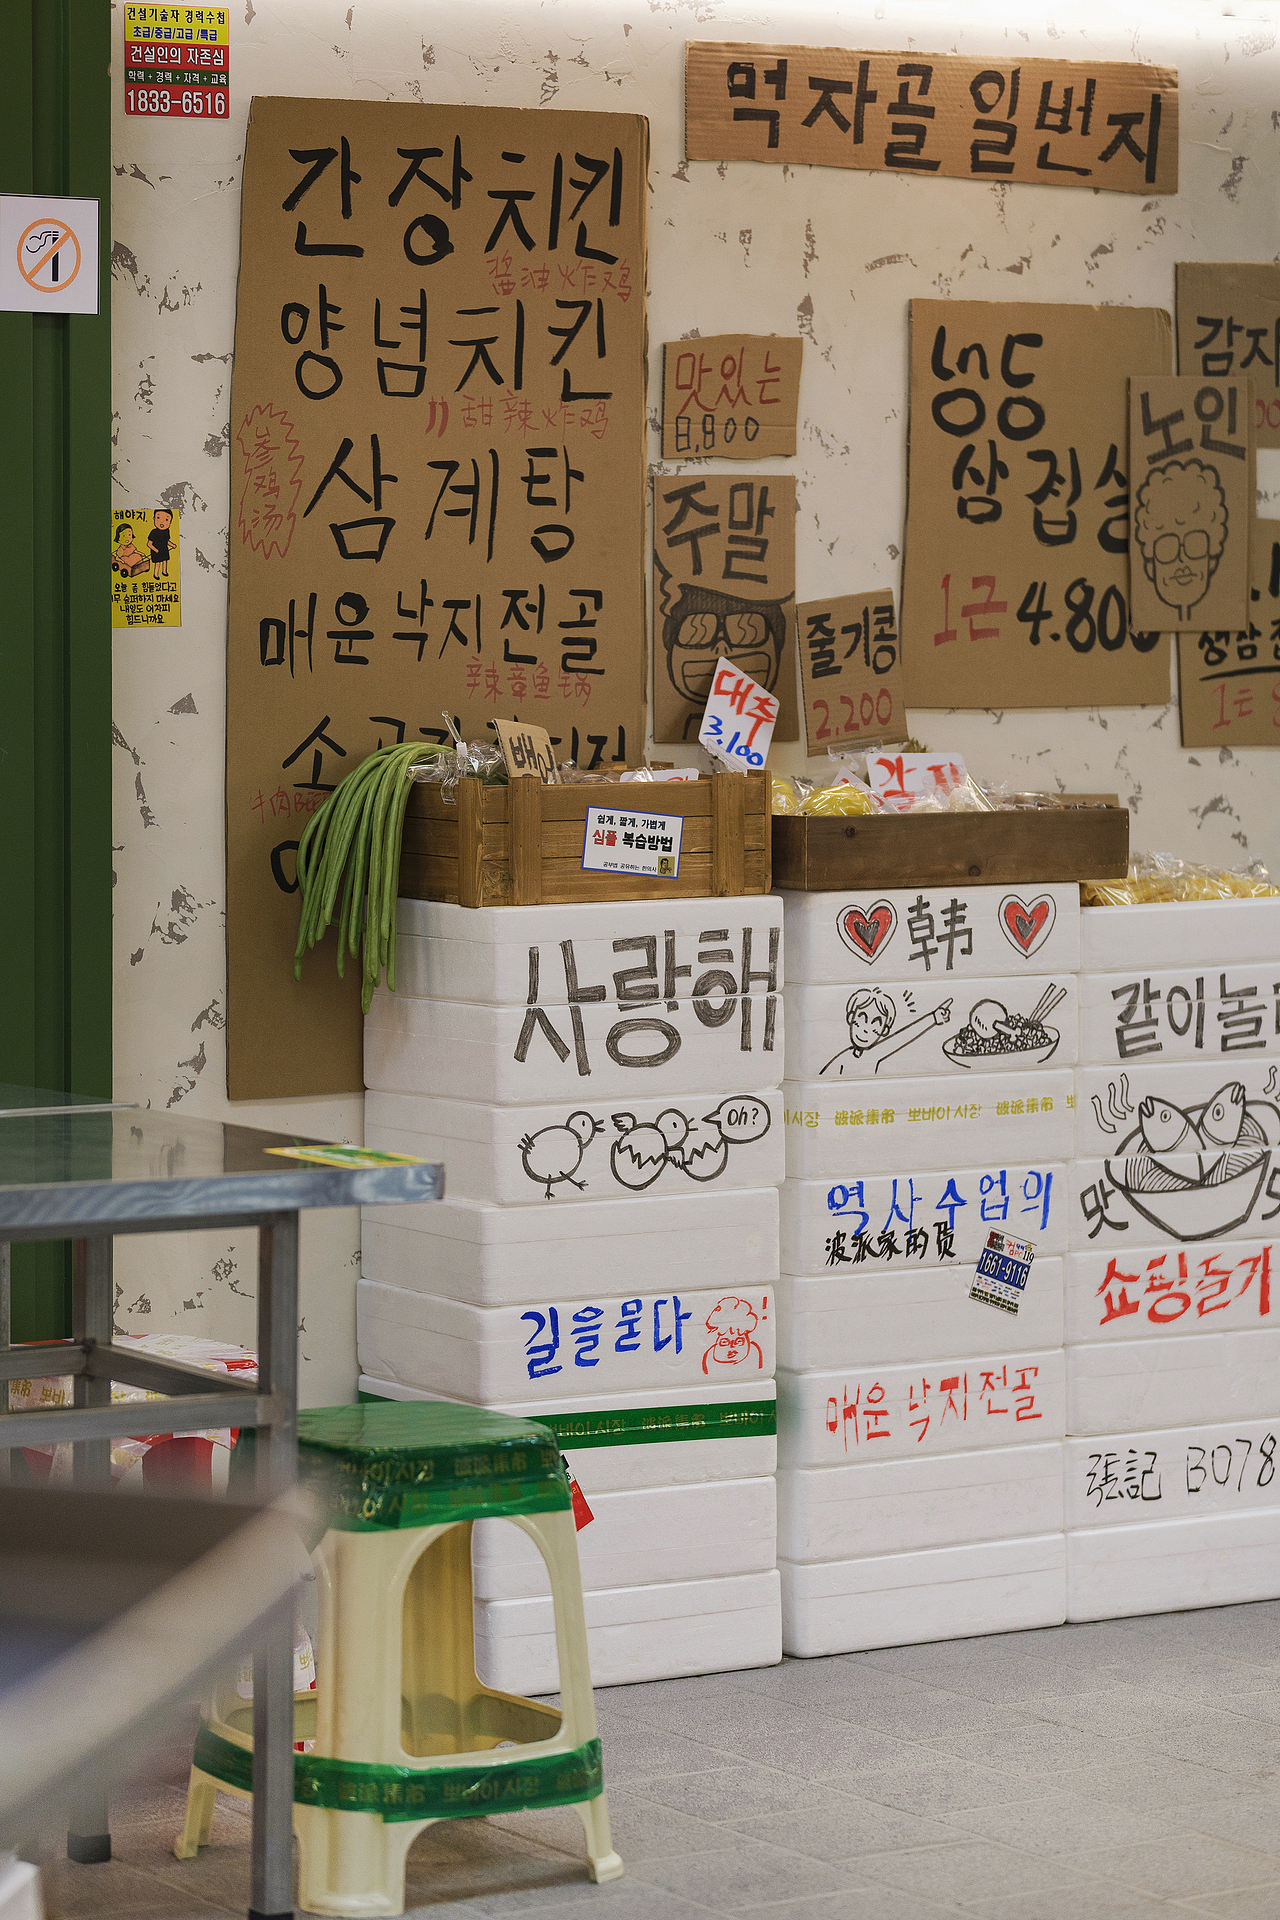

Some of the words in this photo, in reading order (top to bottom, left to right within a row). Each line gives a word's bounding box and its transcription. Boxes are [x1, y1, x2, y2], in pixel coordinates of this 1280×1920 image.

[127, 7, 180, 22] 건설기술자
[185, 10, 225, 24] 경력수첩
[128, 70, 145, 82] 학력
[156, 71, 172, 83] 경력
[183, 72, 200, 84] 자격
[210, 73, 227, 85] 교육
[130, 46, 181, 65] 건설인의
[186, 47, 224, 66] 자존심
[127, 89, 226, 115] 1833-6516
[727, 58, 941, 171] 먹자골
[969, 66, 1162, 184] 일번지
[282, 134, 622, 265] 간장치킨
[281, 284, 613, 401] 양념치킨
[676, 346, 781, 416] 맛있는
[1140, 386, 1246, 464] 노인
[303, 433, 584, 563] 삼계탕
[662, 481, 776, 584] 주말
[120, 604, 143, 613] 내일도
[146, 604, 170, 613] 어차피
[806, 604, 898, 679] 줄기콩
[713, 669, 777, 747] 대추
[592, 829, 617, 846] 심플
[622, 832, 673, 852] 복습방법
[514, 927, 780, 1076] 사랑해
[727, 1107, 759, 1126] Oh?
[979, 1252, 1029, 1288] 1661-9116
